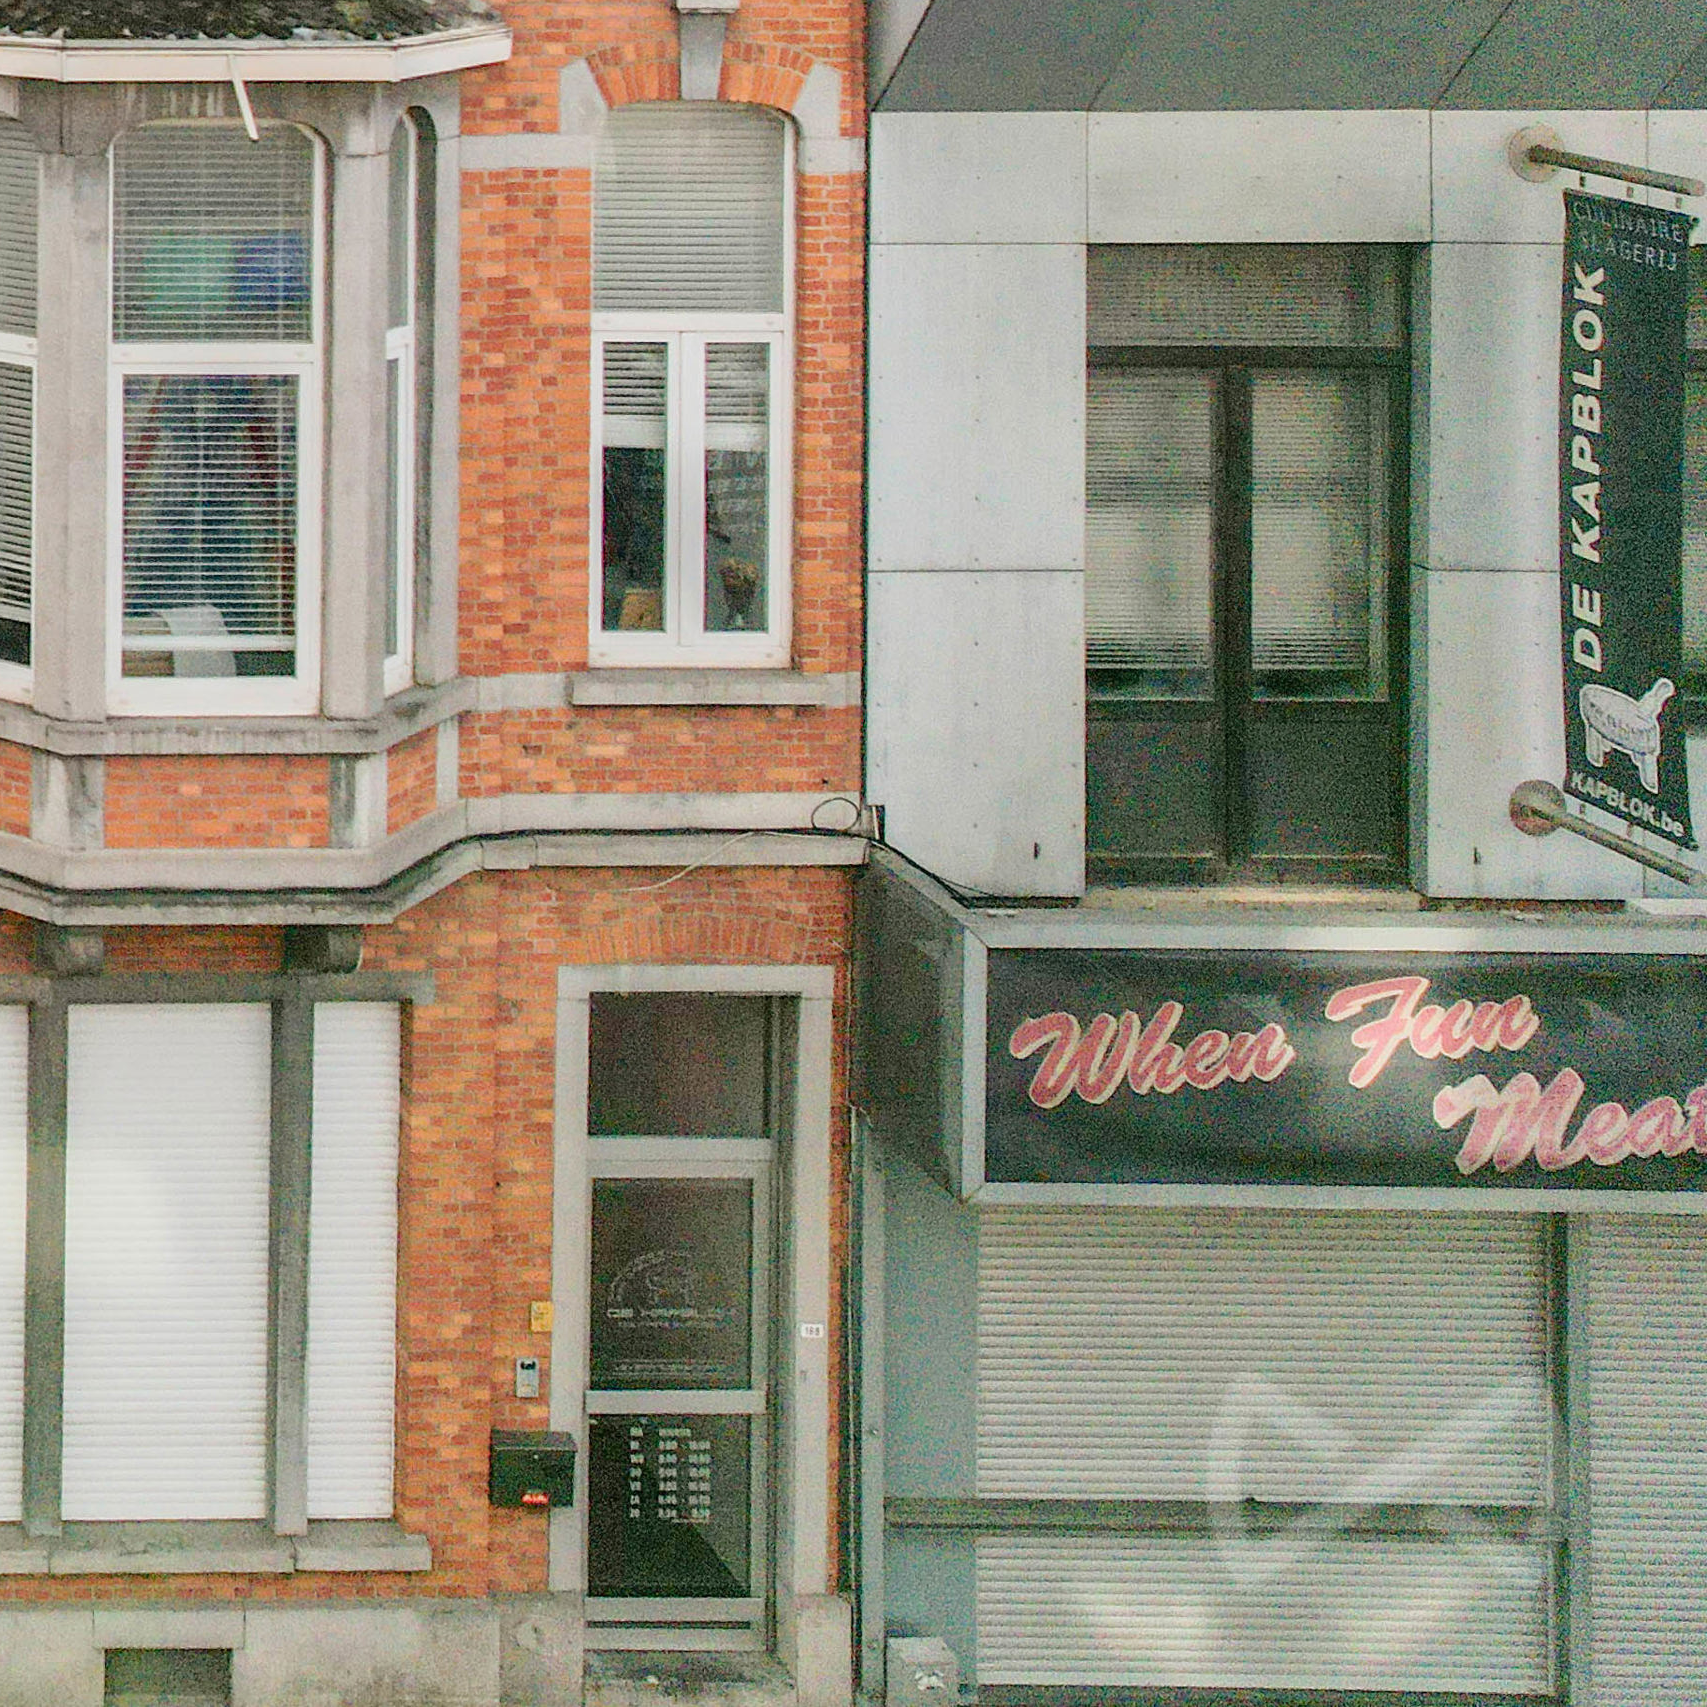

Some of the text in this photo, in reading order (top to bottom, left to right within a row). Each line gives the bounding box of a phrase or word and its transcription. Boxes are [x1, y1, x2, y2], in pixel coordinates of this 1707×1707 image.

[1572, 262, 1605, 672] DE KAPBLOK
[1010, 976, 1539, 1108] When Fun
